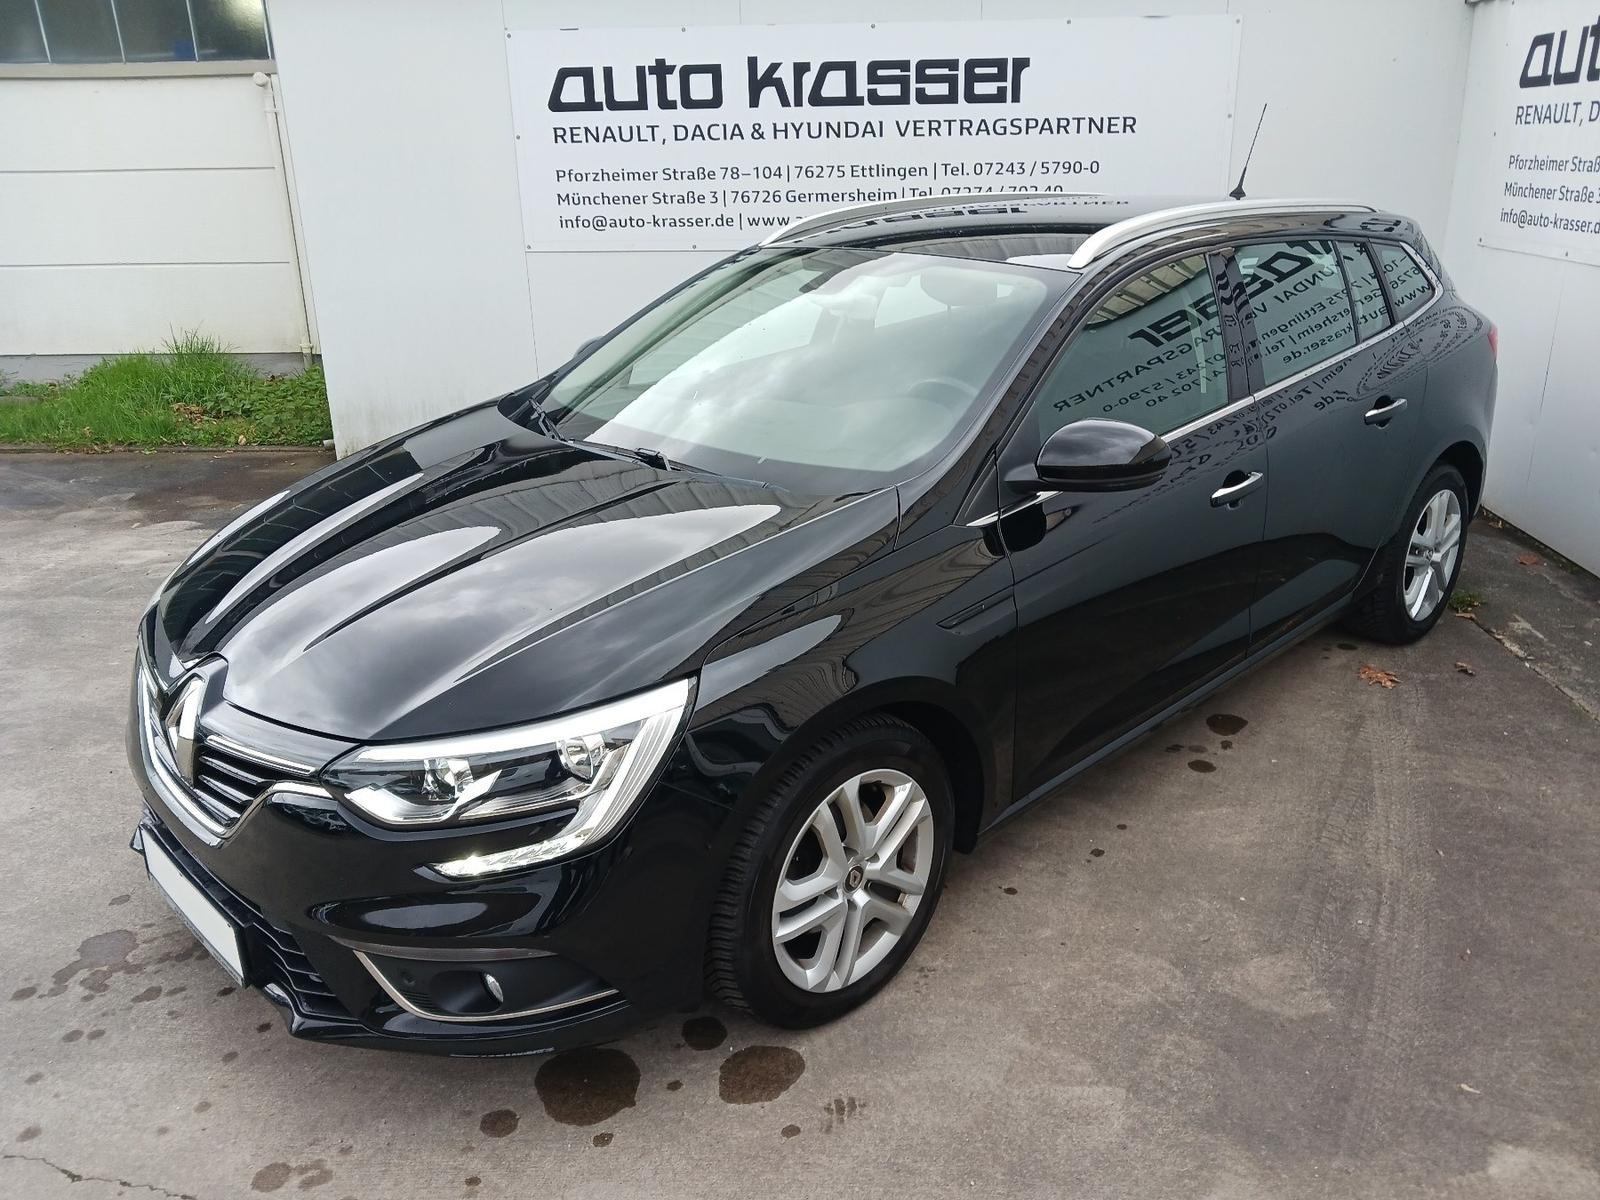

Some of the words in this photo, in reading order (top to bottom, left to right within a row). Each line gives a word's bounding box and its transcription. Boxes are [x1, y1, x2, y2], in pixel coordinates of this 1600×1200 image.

[1519, 14, 1600, 88] aut
[548, 58, 723, 112] auto
[747, 55, 1030, 108] krasser
[1515, 101, 1583, 127] RENAULT,
[1588, 100, 1600, 122] D
[553, 125, 666, 144] RENAULT,
[673, 123, 744, 141] DACIA
[750, 122, 765, 139] &
[772, 120, 884, 139] HYUNDAI
[896, 116, 1136, 138] VERTRAGSPARTNER
[556, 169, 658, 182] Pforzheimer
[662, 167, 716, 182] Straße
[795, 164, 846, 179] 76275
[851, 162, 928, 181] Ettlingen
[941, 162, 970, 177] Tel.
[973, 161, 1026, 176] 07243
[1040, 160, 1100, 174] 5790-0
[1508, 155, 1569, 172] Pforzheimer
[1570, 156, 1600, 173] Straß
[556, 192, 648, 206] Münchener
[652, 191, 706, 206] Straße
[709, 191, 719, 204] 3
[731, 189, 782, 204] 76726
[786, 188, 897, 203] Germersheim
[909, 187, 934, 197] Tel
[1504, 182, 1558, 200] Münchener
[1559, 186, 1595, 203] Straße
[559, 213, 734, 231] info@auto-krasser.de
[1500, 207, 1600, 235] info@auto-krasser.d
